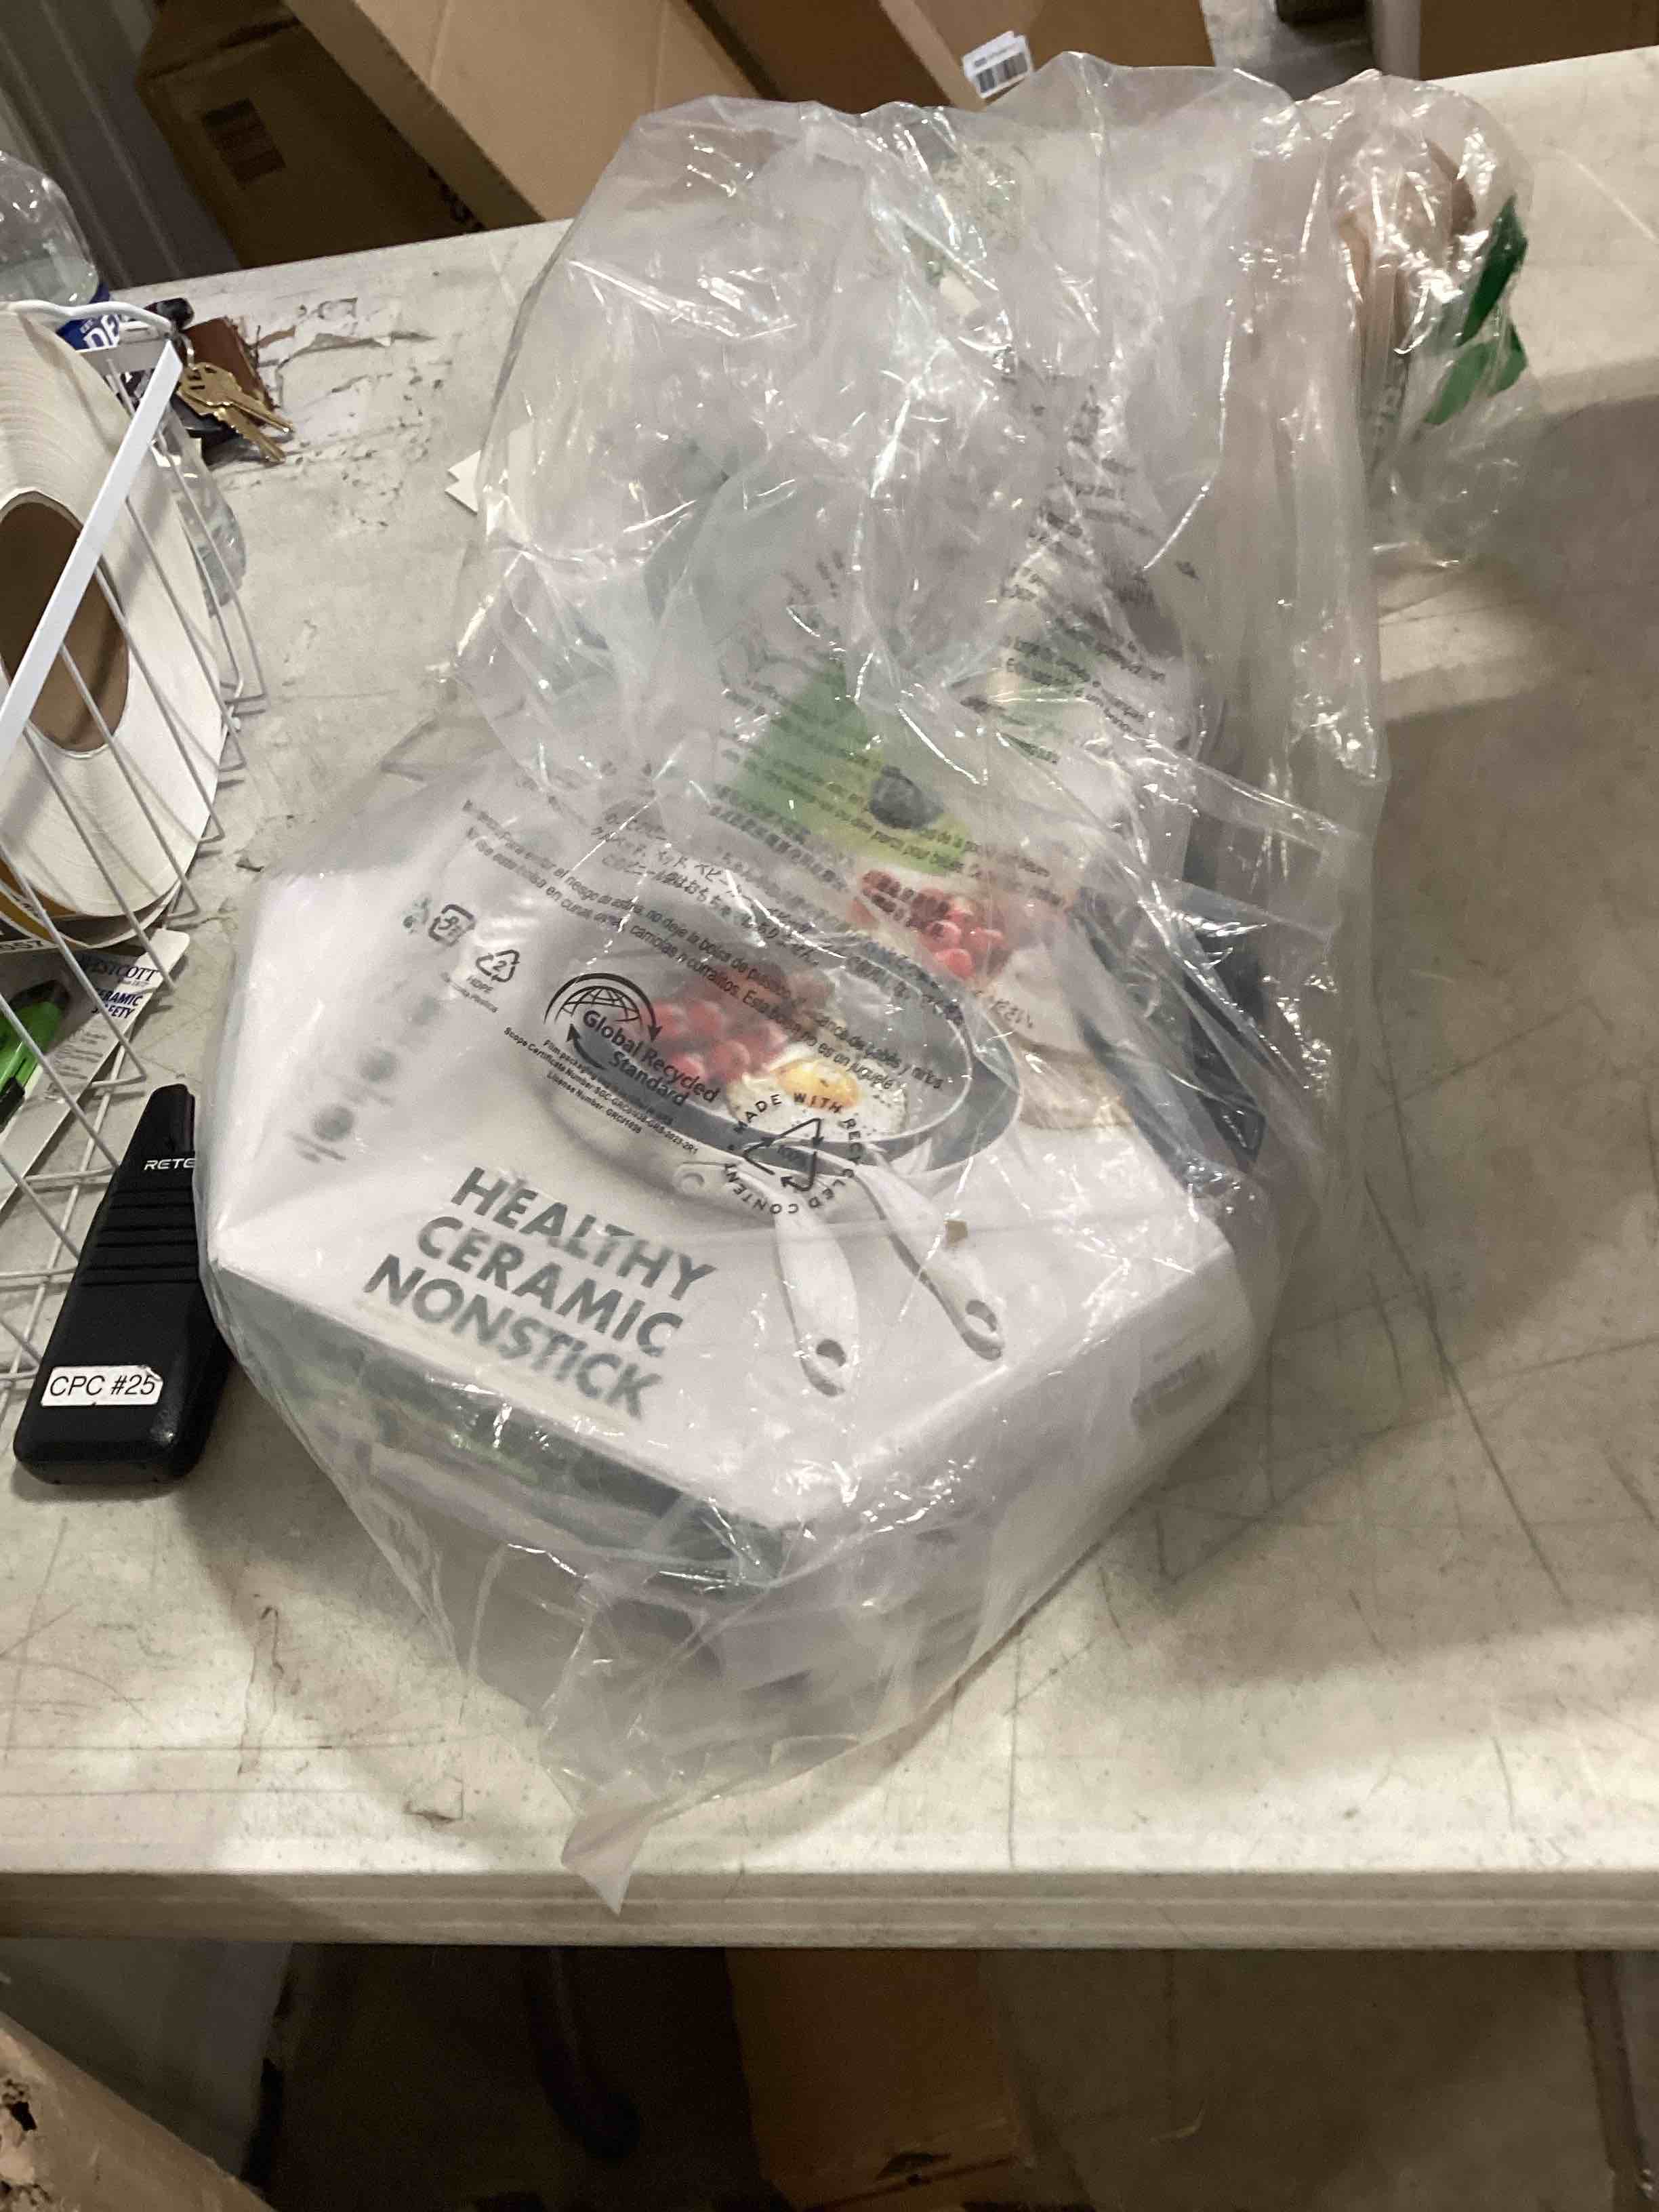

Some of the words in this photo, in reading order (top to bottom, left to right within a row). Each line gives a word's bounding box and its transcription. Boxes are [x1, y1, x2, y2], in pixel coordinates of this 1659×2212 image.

[80, 954, 159, 982] STCOTT
[493, 960, 508, 972] 2
[98, 988, 144, 1007] ERAMIC
[583, 1010, 644, 1057] Global
[642, 1048, 721, 1102] Recycled
[609, 1051, 690, 1106] Standard
[794, 1092, 843, 1113] WITH
[724, 1163, 799, 1214] CONTENT
[451, 1166, 717, 1300] HEALTHY
[417, 1216, 683, 1356] CERAMIC
[364, 1254, 662, 1418] NONSTICK
[49, 1375, 105, 1397] CPC
[110, 1374, 156, 1396] #25
